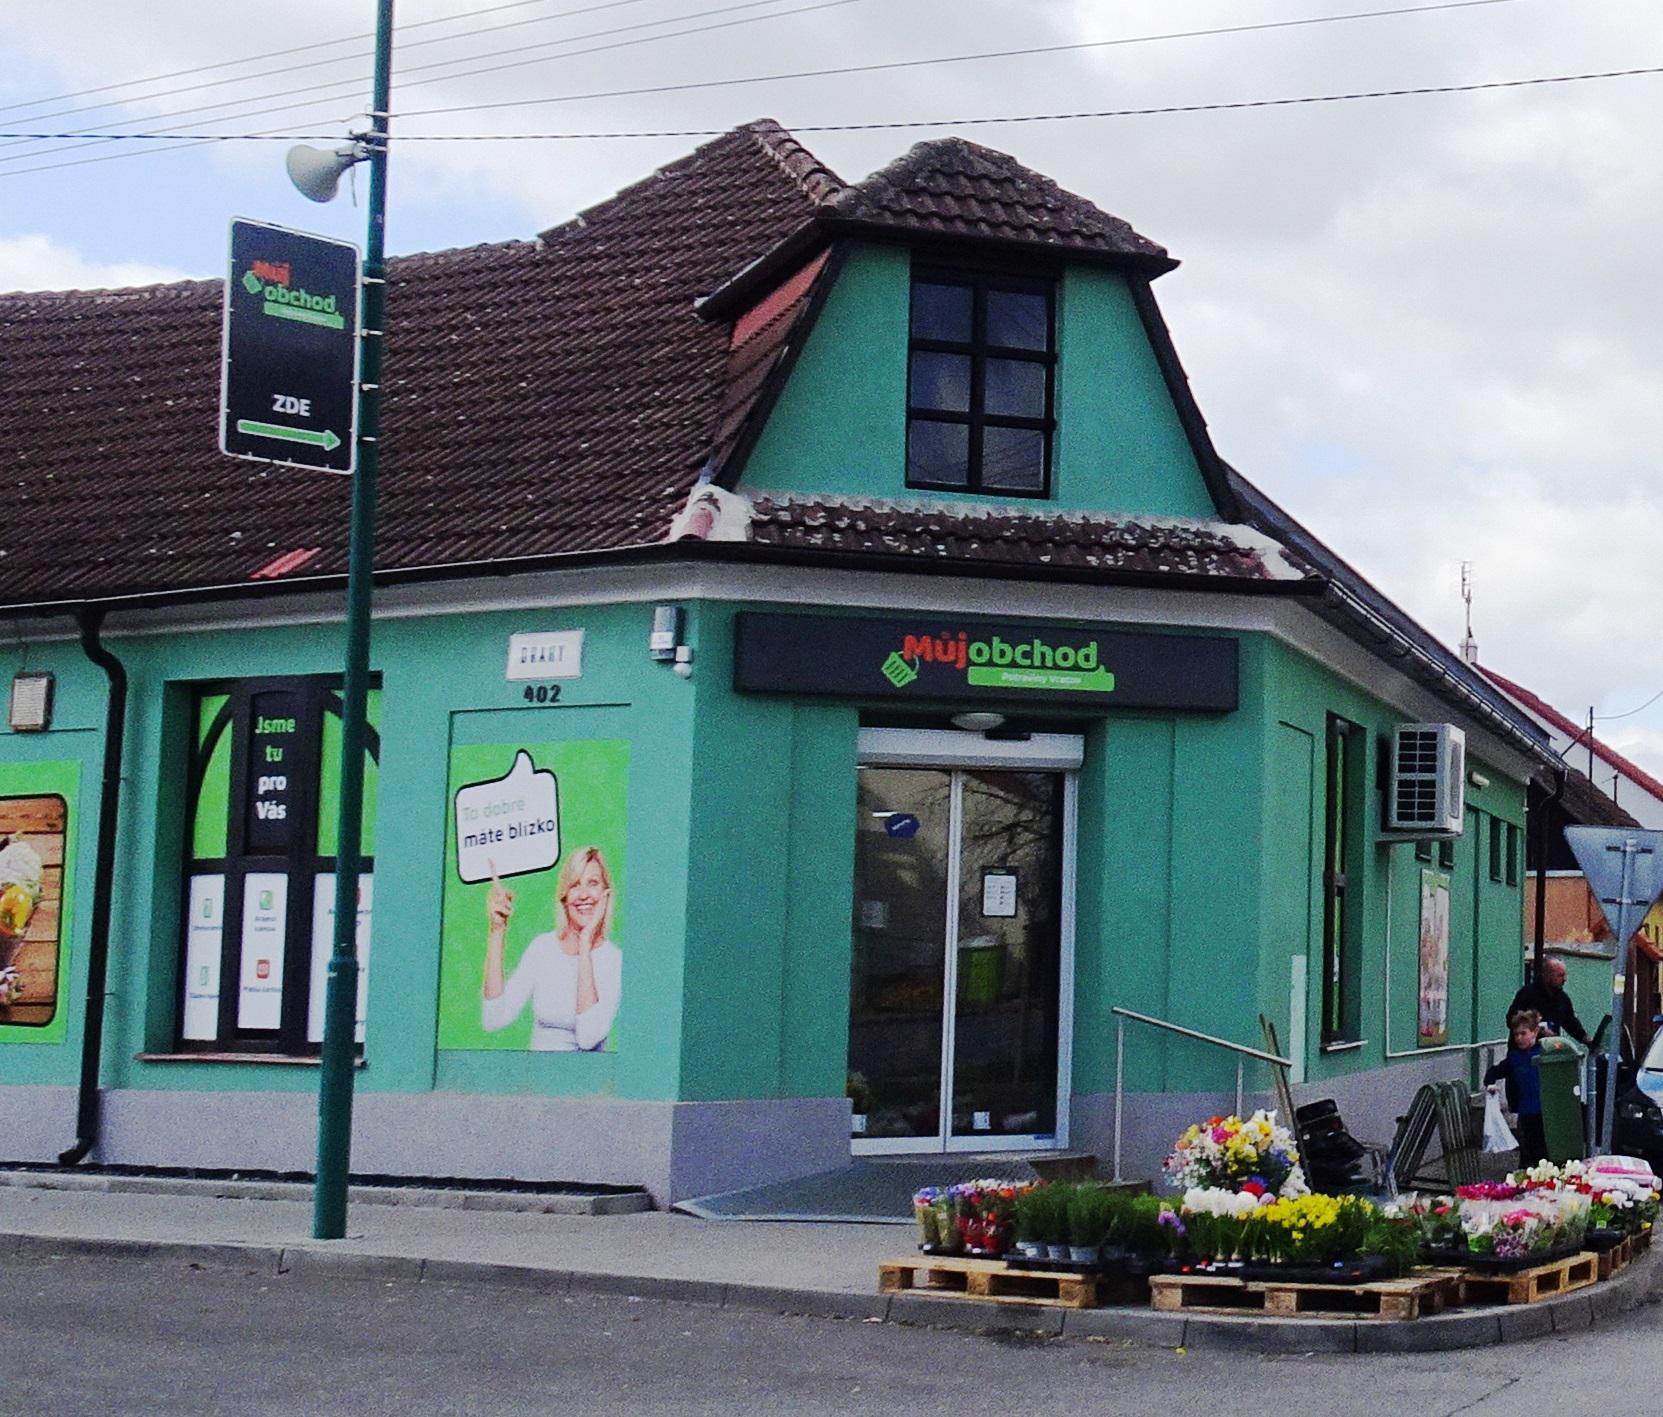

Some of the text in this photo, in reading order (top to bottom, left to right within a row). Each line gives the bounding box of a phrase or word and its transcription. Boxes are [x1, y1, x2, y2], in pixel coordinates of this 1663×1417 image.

[264, 283, 337, 313] obchod
[272, 394, 312, 417] ZDE
[523, 684, 562, 703] 402
[255, 716, 296, 734] Jsme
[265, 745, 283, 762] tu
[257, 776, 287, 795] pro
[256, 800, 287, 820] Vás
